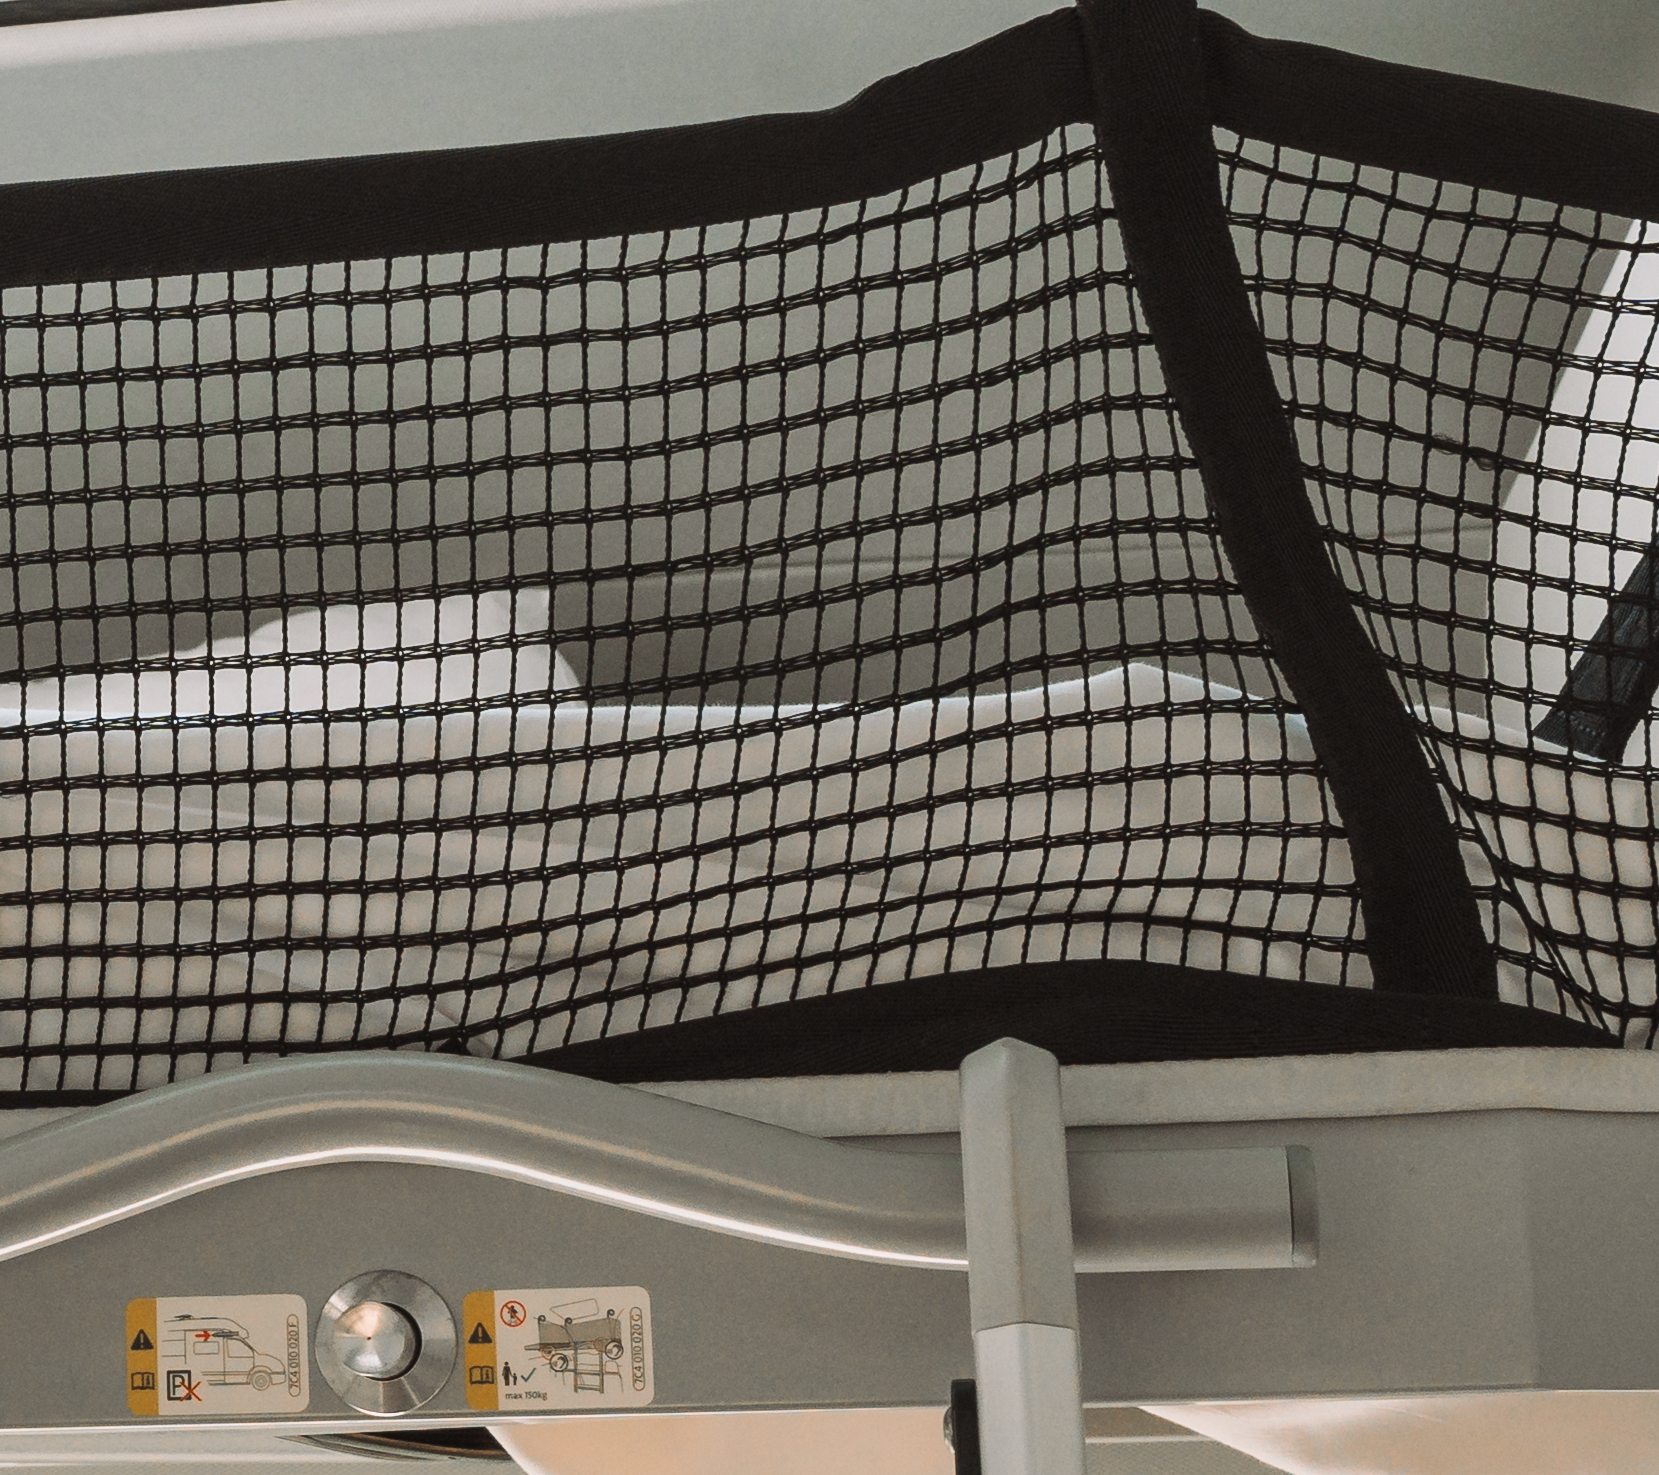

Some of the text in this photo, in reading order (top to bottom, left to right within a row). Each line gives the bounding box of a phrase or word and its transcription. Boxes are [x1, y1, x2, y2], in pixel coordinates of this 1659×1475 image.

[288, 1330, 298, 1349] 020
[631, 1314, 644, 1384] 7C4 010 020 G
[289, 1351, 299, 1369] 010
[290, 1371, 299, 1389] 7C4
[525, 1390, 548, 1401] 150kg
